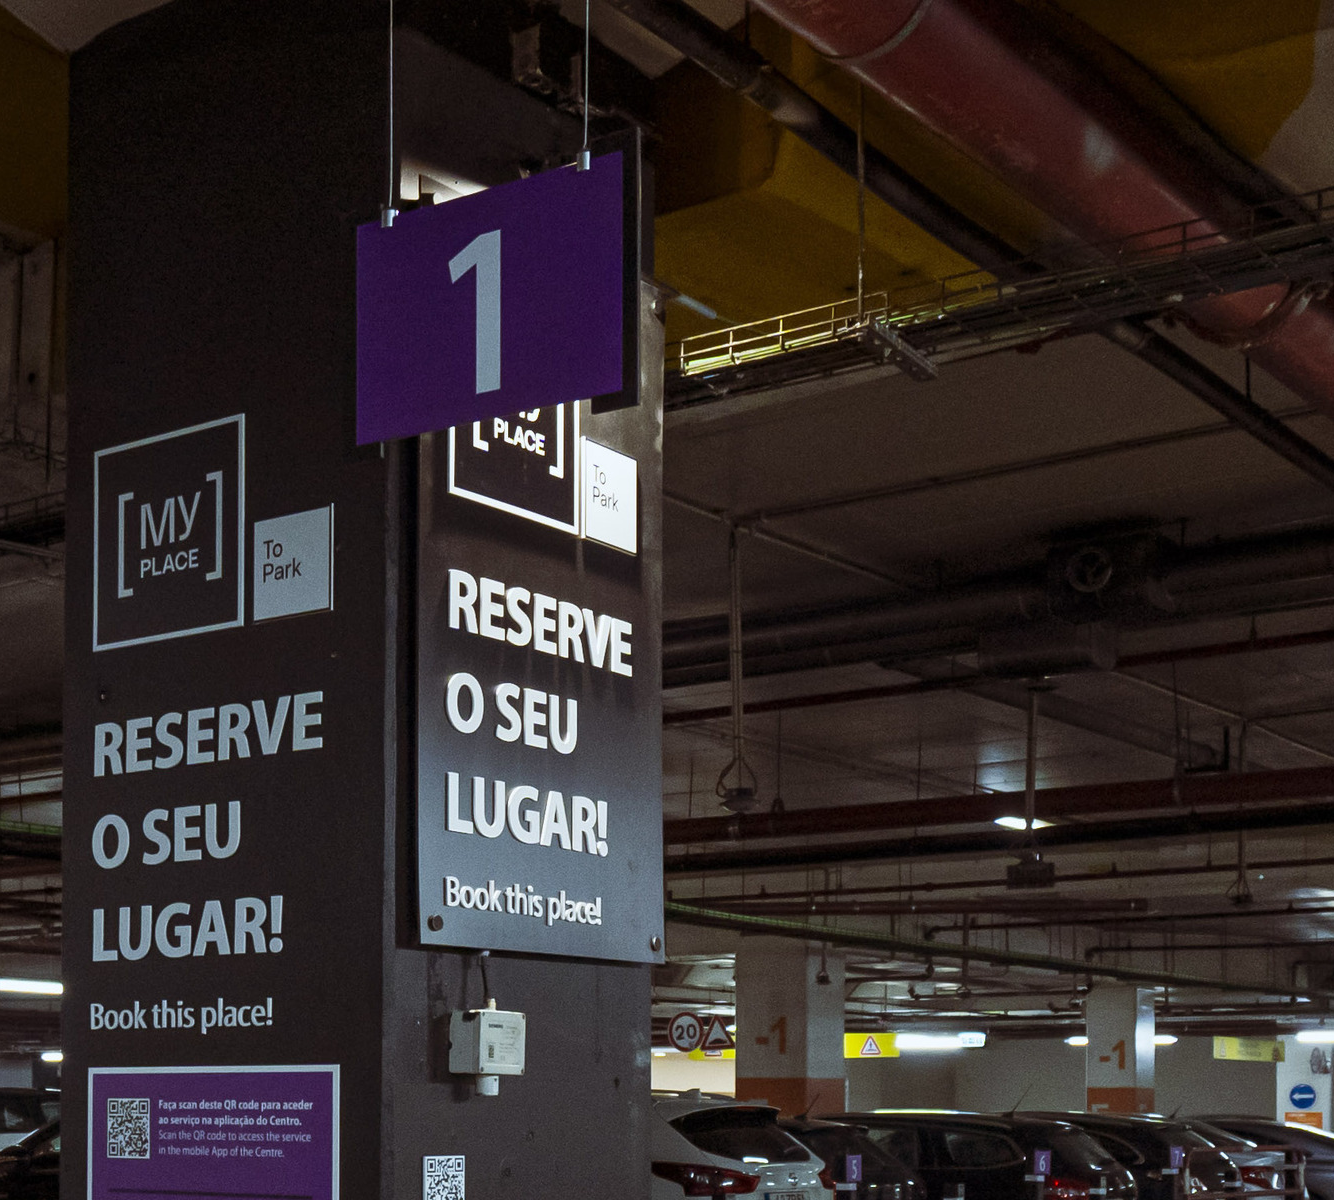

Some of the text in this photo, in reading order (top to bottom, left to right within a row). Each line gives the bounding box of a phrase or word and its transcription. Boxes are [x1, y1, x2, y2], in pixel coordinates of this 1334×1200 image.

[448, 229, 501, 395] 1
[494, 419, 546, 457] PLACE
[592, 464, 606, 485] To
[592, 487, 619, 512] Park
[140, 548, 199, 579] PLACE
[263, 539, 284, 560] To
[262, 559, 302, 583] Park
[448, 569, 633, 677] RESERVE
[447, 672, 578, 754] O SEU
[93, 691, 323, 777] RESERVE
[446, 771, 608, 857] LUGAR!
[91, 800, 241, 869] O SEU
[445, 876, 602, 926] Book this place!
[92, 894, 284, 962] LUGAR!
[89, 997, 273, 1035] Book this place!
[675, 1023, 697, 1040] 20
[755, 1016, 786, 1054] -1
[1099, 1040, 1125, 1070] -1
[158, 1099, 313, 1112] Faça scan deste QR code para aceder
[158, 1115, 302, 1128] ao serviço na aplicação do Centro.
[158, 1129, 312, 1143] Scan the QR code to access the service
[158, 1145, 166, 1155] in
[167, 1145, 181, 1155] the
[182, 1145, 210, 1156] mobile
[211, 1146, 228, 1158] App
[229, 1146, 239, 1157] of
[239, 1146, 253, 1157] the
[1039, 1156, 1046, 1171] 6
[851, 1159, 858, 1180] 5
